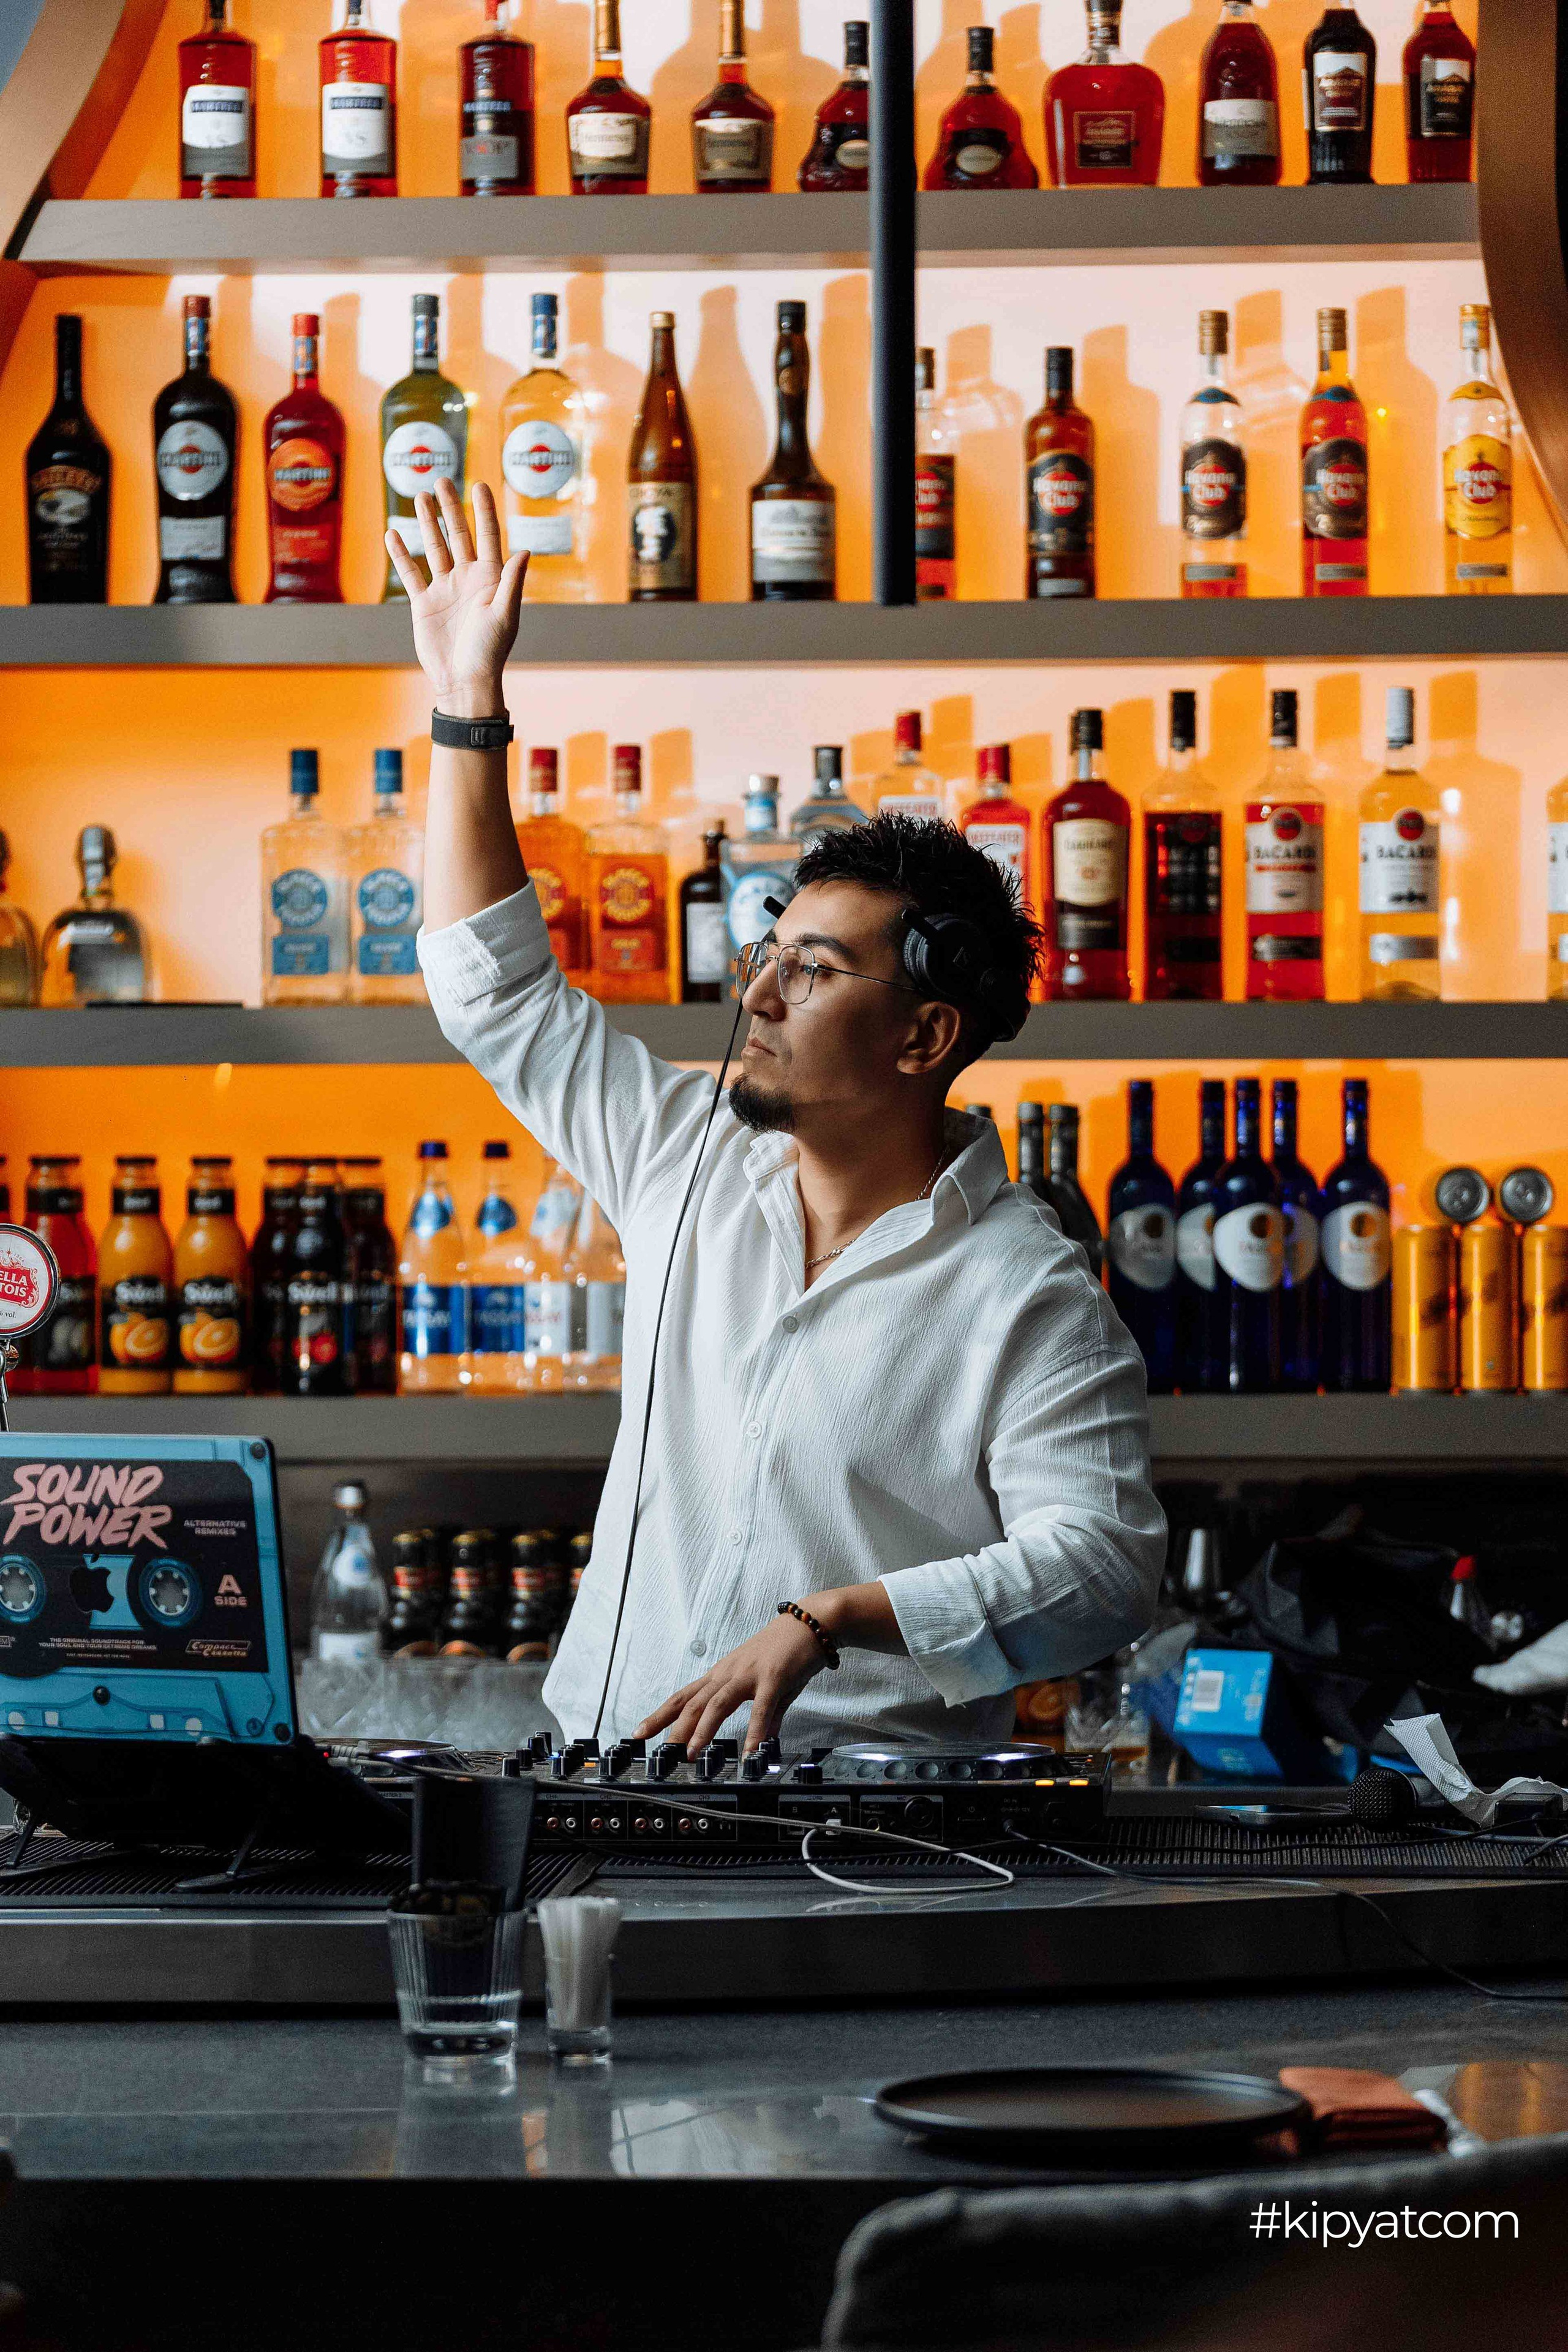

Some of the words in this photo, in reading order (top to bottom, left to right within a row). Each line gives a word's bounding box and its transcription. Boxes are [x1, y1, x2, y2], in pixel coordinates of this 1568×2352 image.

[0, 1463, 164, 1506] SOUND
[2, 1502, 173, 1549] POWER
[184, 1519, 247, 1529] ALTERNATIVE
[217, 1574, 243, 1595] A
[214, 1595, 248, 1608] SIDE
